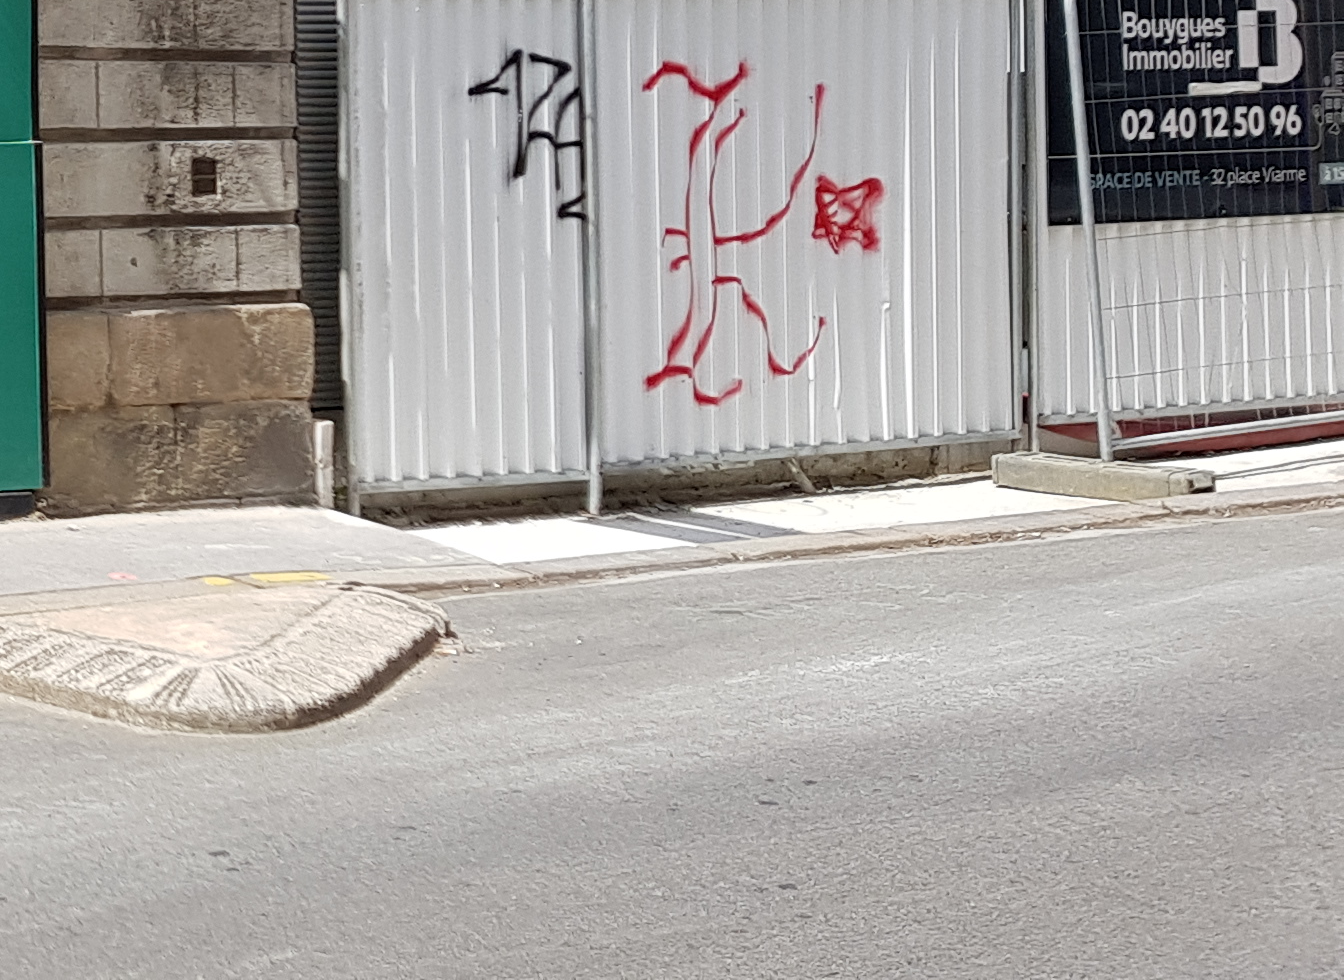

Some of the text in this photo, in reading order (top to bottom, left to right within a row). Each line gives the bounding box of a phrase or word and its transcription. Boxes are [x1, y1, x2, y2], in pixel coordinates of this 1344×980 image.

[1122, 11, 1226, 44] Bouygues
[1122, 42, 1234, 71] Immobilier
[1120, 105, 1302, 141] 02 40 12 50 96
[1089, 172, 1132, 189] SPACE
[1134, 172, 1153, 188] DE
[1155, 170, 1201, 187] VENTE
[1227, 167, 1261, 188] place
